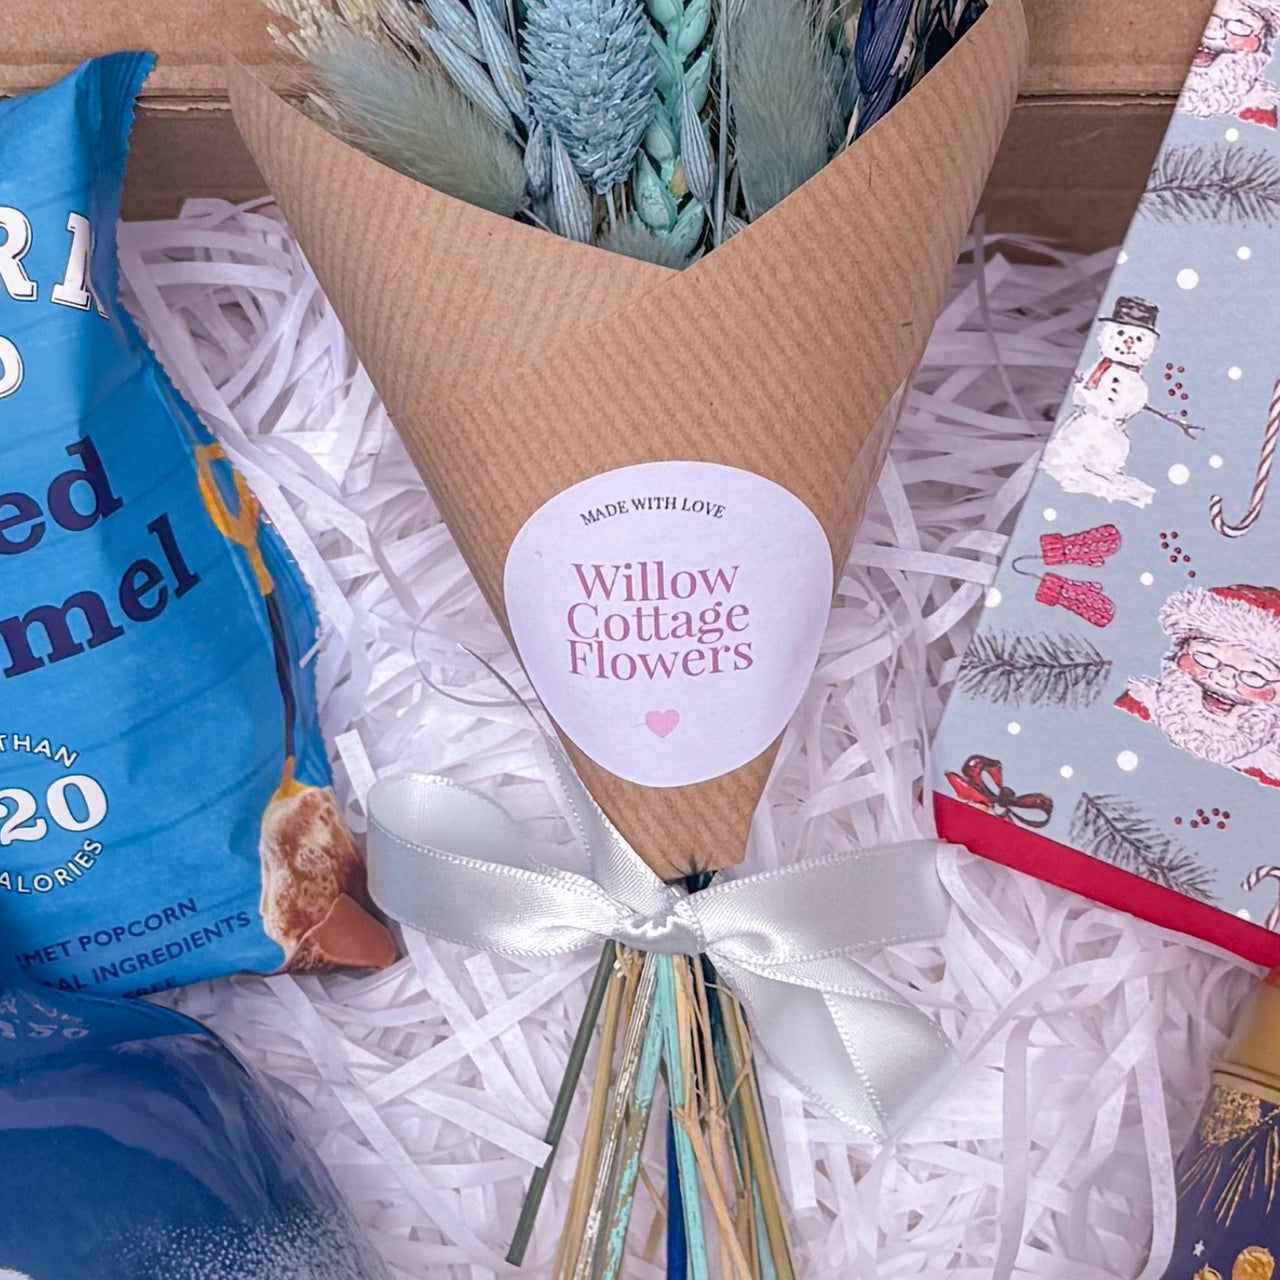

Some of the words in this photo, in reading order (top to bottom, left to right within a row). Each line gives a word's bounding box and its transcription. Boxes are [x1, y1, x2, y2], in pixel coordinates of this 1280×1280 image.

[579, 500, 629, 526] MADE
[631, 496, 677, 512] WITH
[680, 498, 727, 520] LOVE
[571, 560, 740, 602] Willow
[567, 601, 750, 644] Cottage
[566, 639, 754, 680] Flowers
[15, 939, 71, 970] MET
[78, 897, 198, 953] POPCORN
[91, 910, 252, 984] INGREDIENTS
